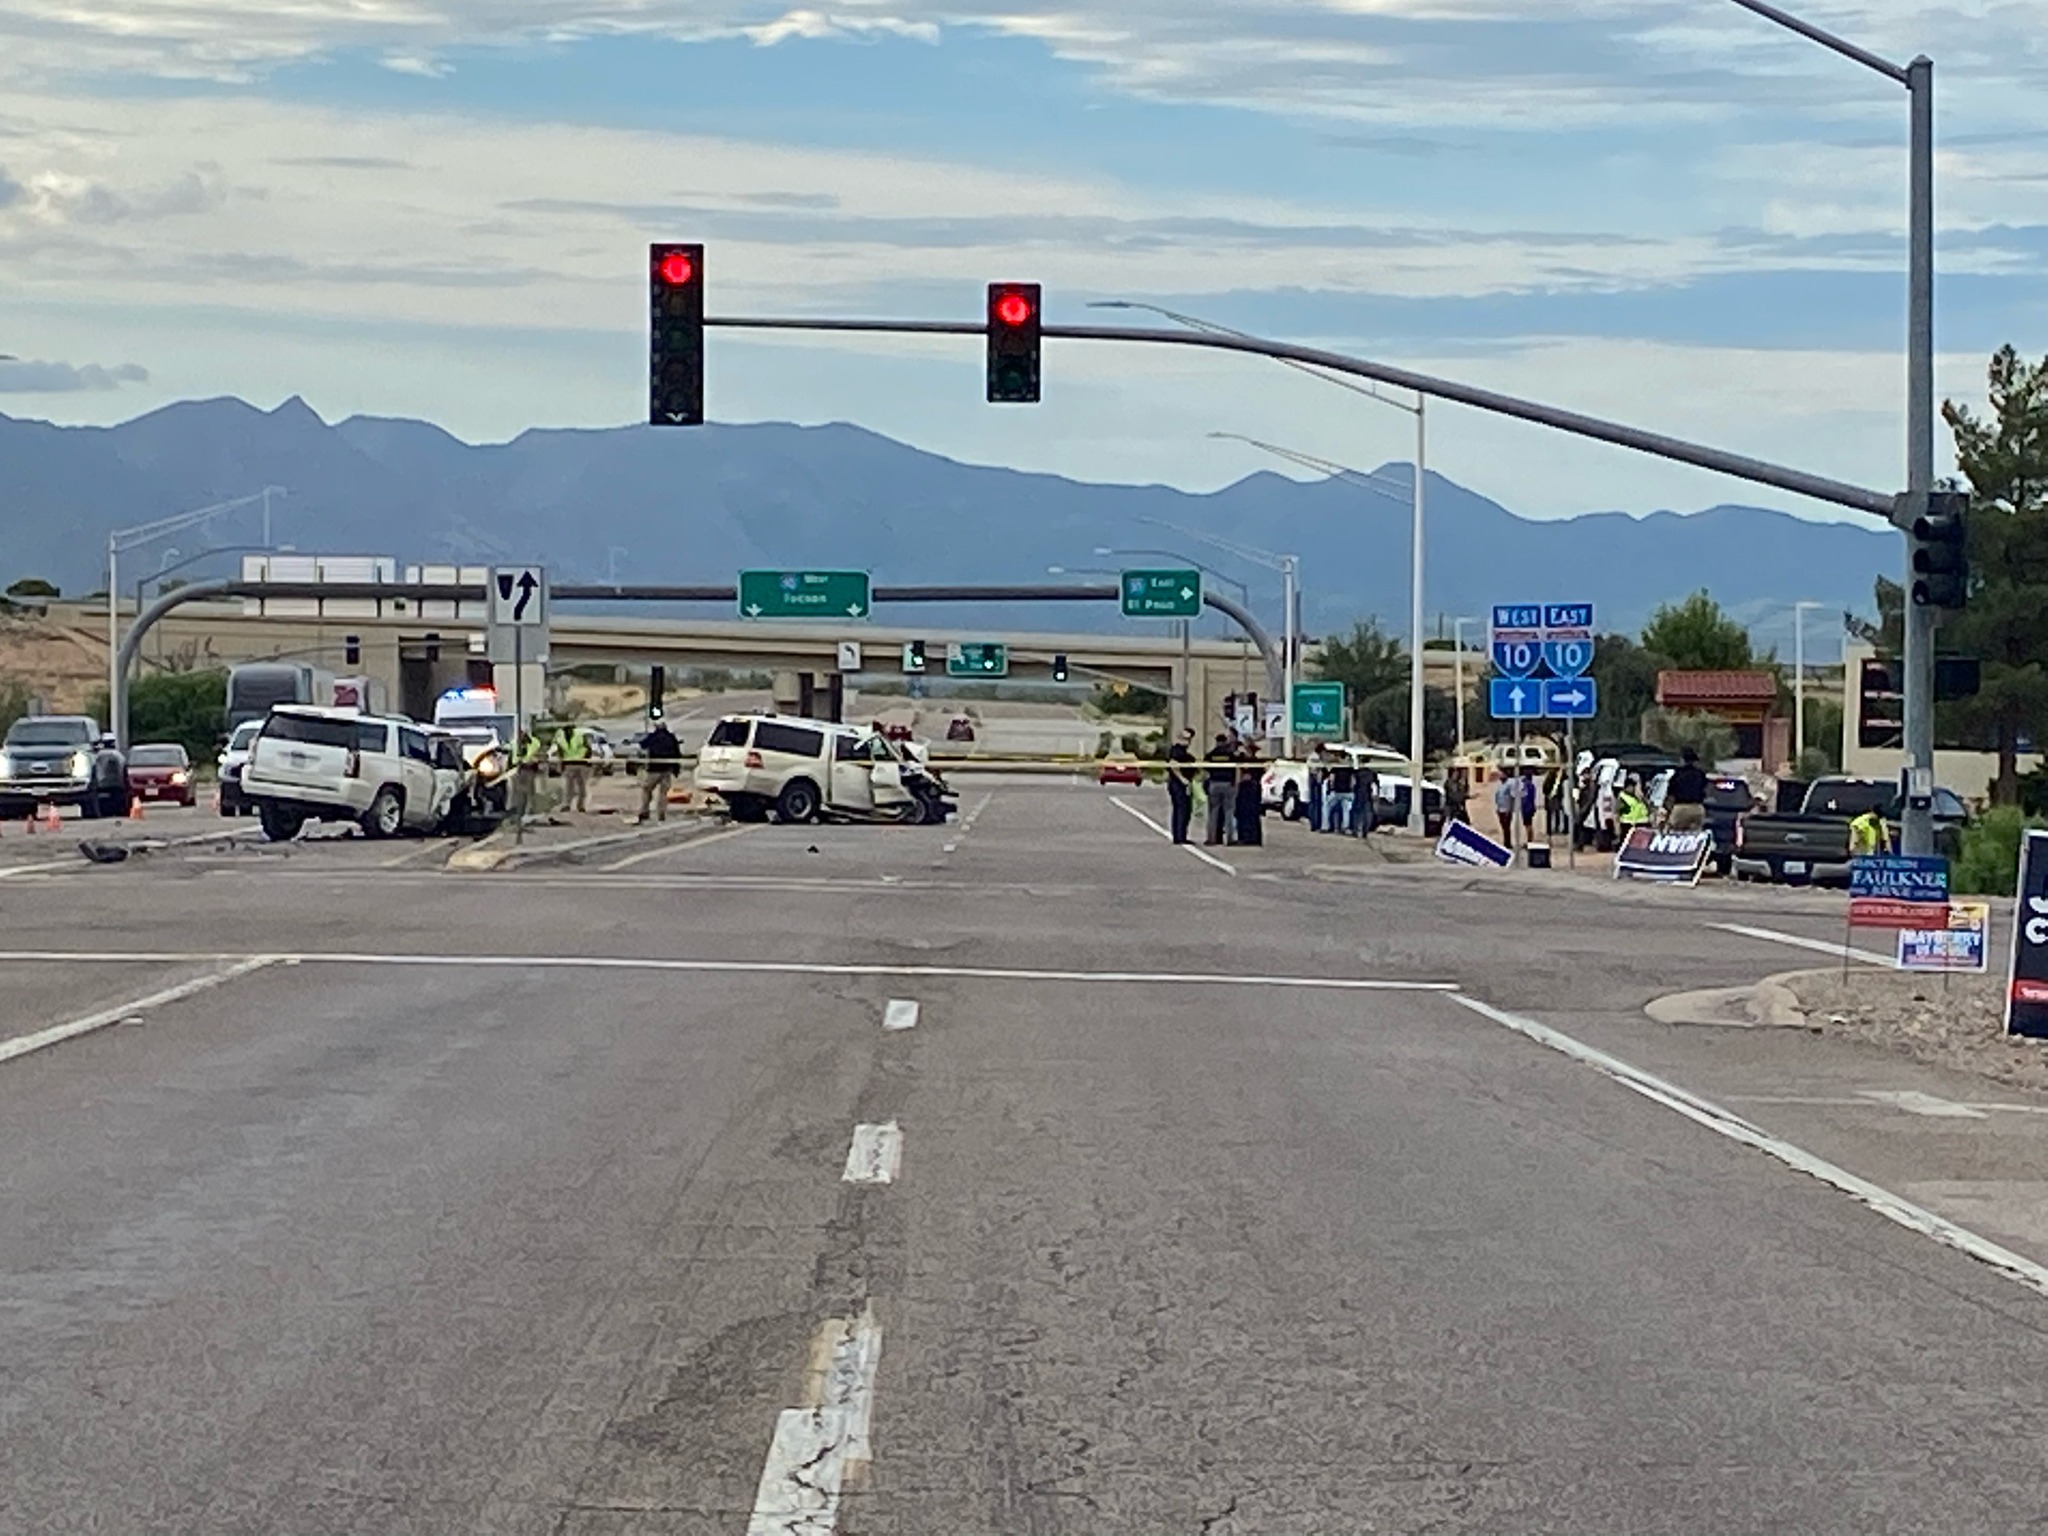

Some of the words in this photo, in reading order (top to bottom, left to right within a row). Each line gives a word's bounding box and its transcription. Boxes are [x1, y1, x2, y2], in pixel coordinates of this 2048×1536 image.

[1498, 608, 1538, 625] WEST
[1550, 608, 1587, 624] EAST
[1504, 644, 1531, 669] 10
[1555, 644, 1582, 667] 10
[1649, 833, 1706, 853] JUAN
[1852, 869, 1947, 888] FAULKNER
